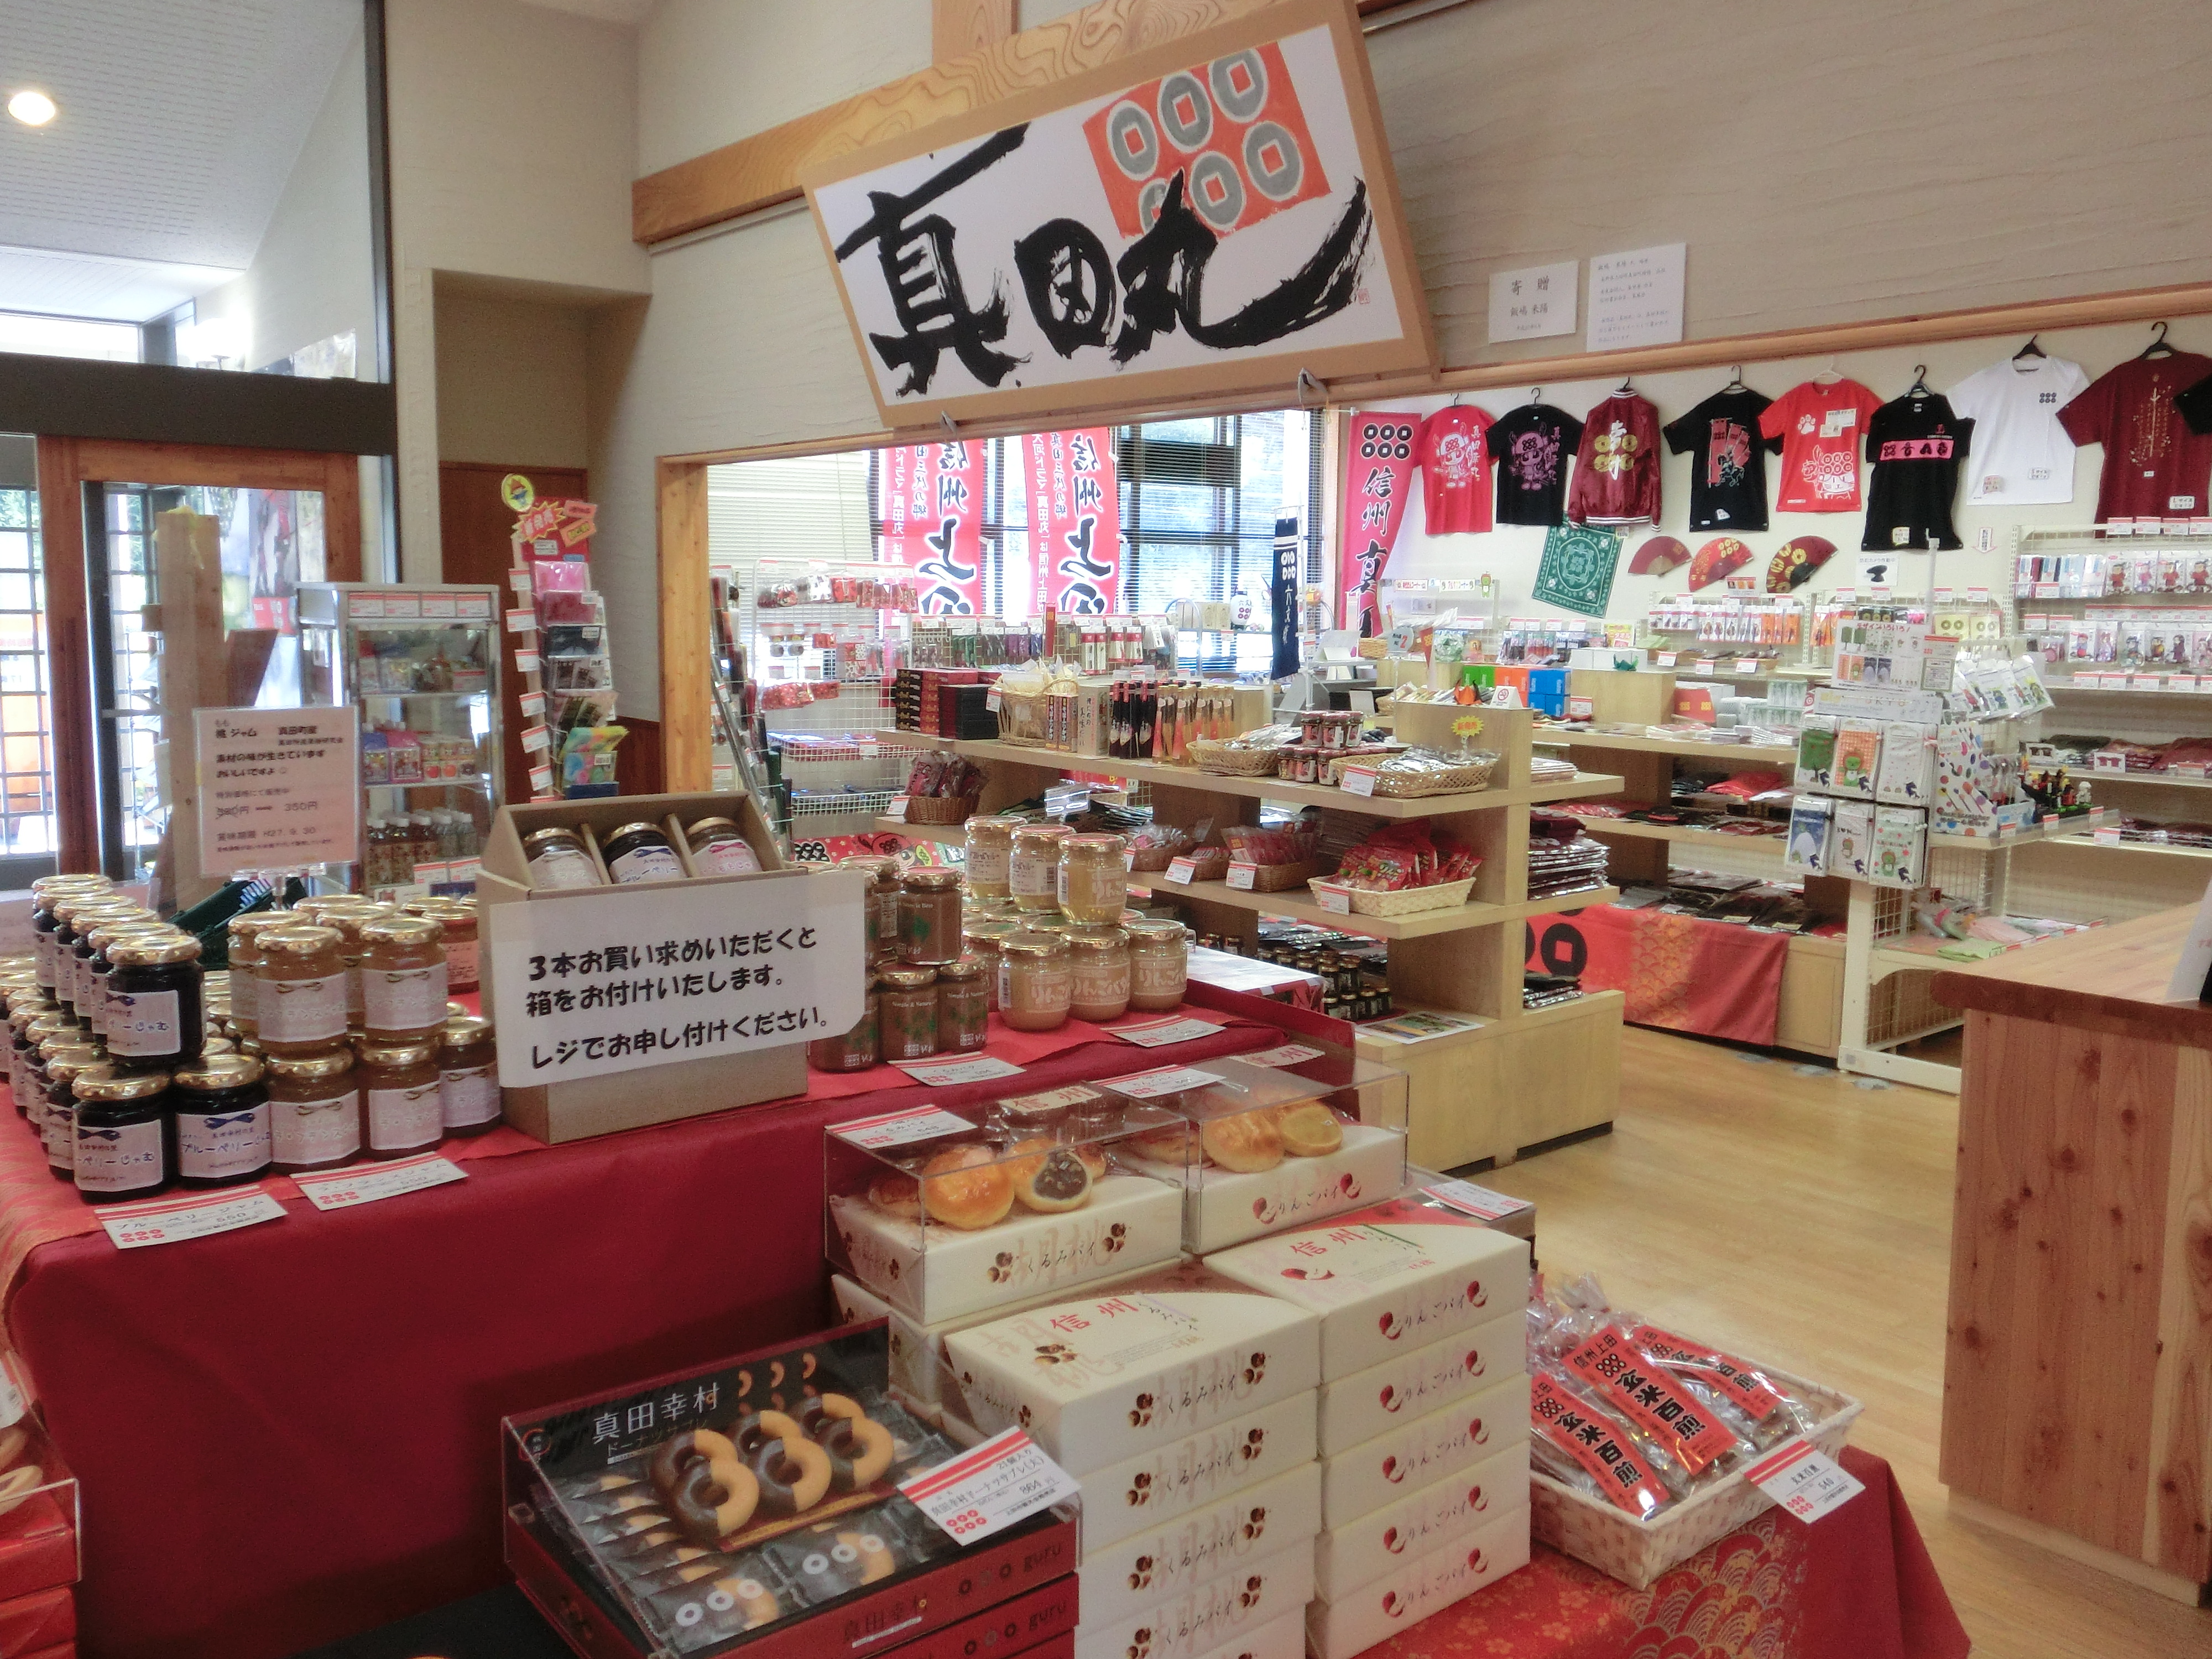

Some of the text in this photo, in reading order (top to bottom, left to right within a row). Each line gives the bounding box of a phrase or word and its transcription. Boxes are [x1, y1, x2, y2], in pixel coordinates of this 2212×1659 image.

[835, 122, 1373, 397] 真田丸
[1350, 466, 1395, 638] 信州真
[528, 927, 817, 981] 3本お買い求めいただくと
[526, 964, 783, 1018] 箱をお付けいたします。
[531, 1006, 828, 1070] レジでお申し付けください。
[1028, 1241, 1095, 1273] くるみパイ
[1290, 1228, 1367, 1257] 信州
[1050, 1297, 1139, 1333] 信州
[593, 1381, 720, 1444] 真田幸村
[1168, 1374, 1235, 1414] くるみパイ
[1167, 1451, 1233, 1490] くるみパイ
[1168, 1531, 1235, 1574] くるみパイ
[1166, 1600, 1232, 1645] くるみパイ
